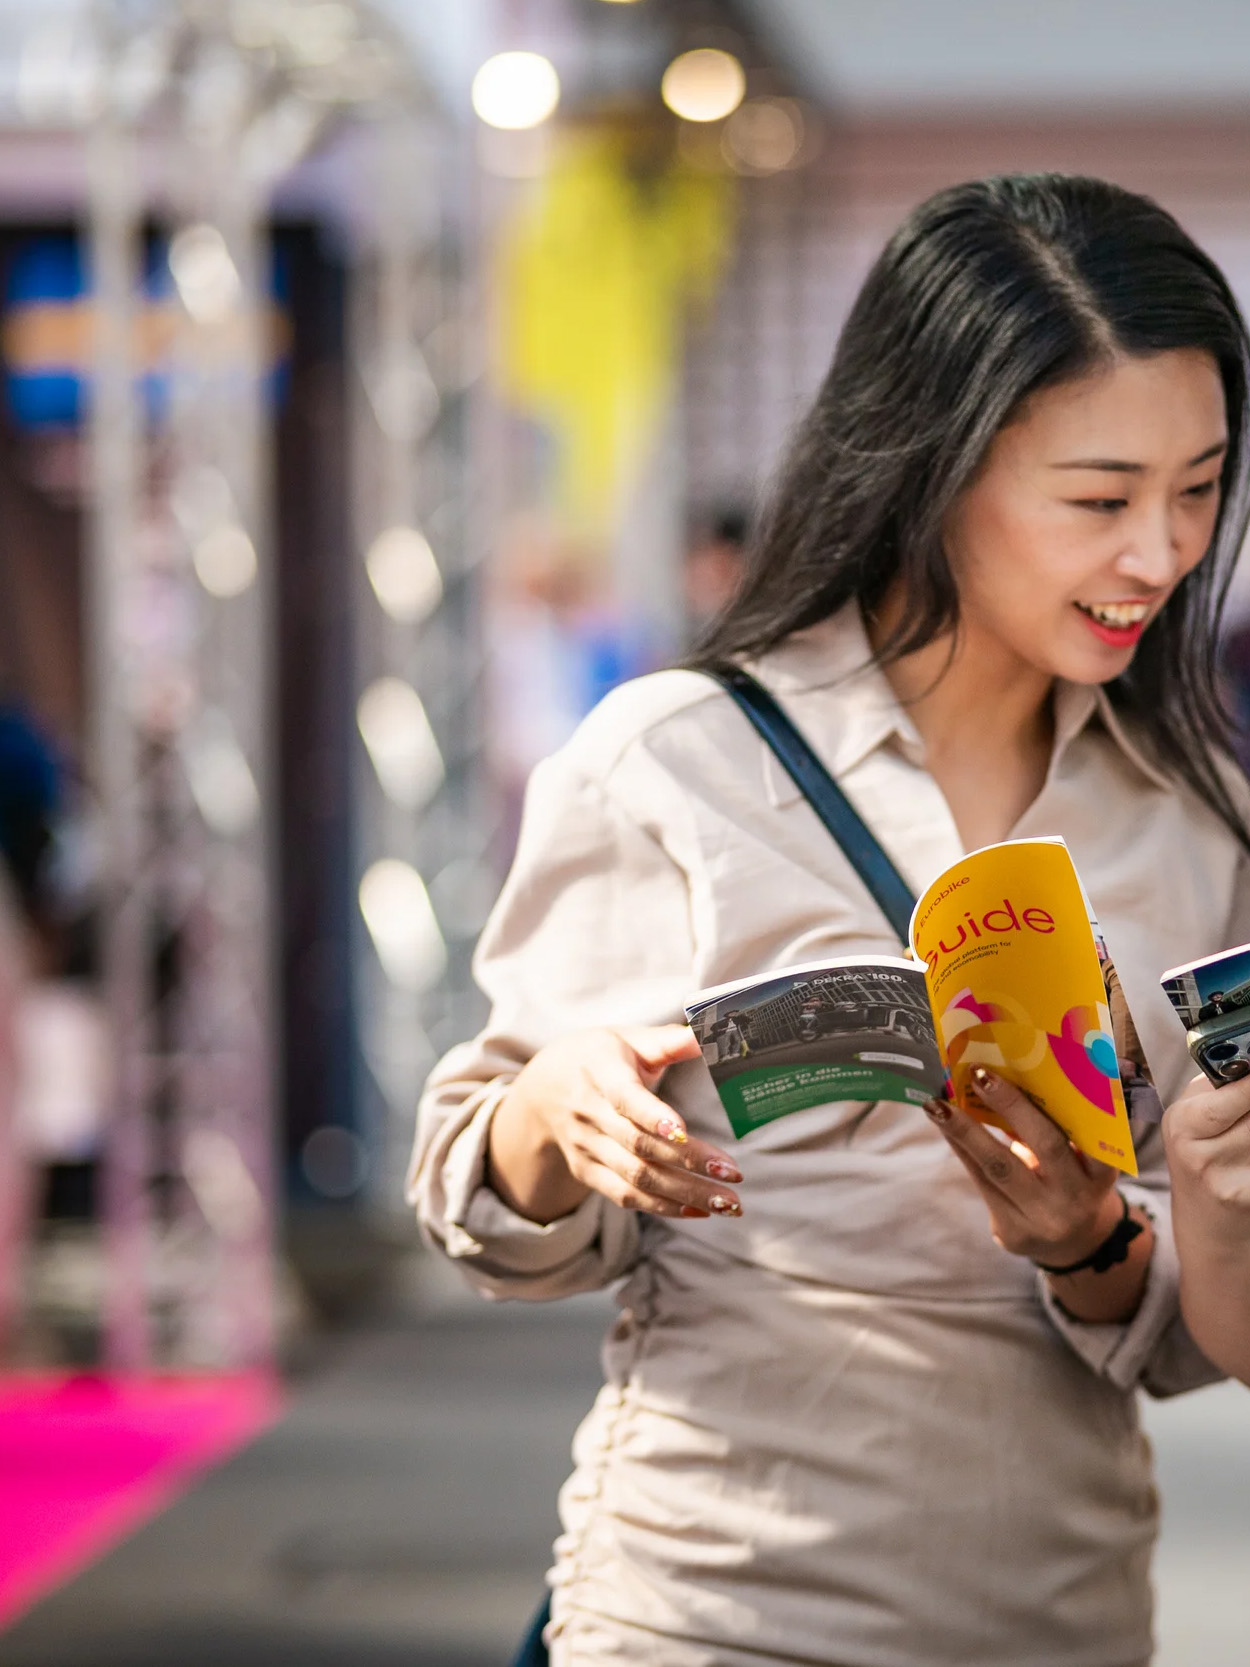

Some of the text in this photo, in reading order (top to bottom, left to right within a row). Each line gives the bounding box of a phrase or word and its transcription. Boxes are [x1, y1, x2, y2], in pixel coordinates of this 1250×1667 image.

[920, 877, 970, 928] Eurobike
[962, 942, 998, 959] platform
[814, 974, 863, 985] DEKRA
[795, 1072, 811, 1081] in
[814, 1067, 841, 1076] die
